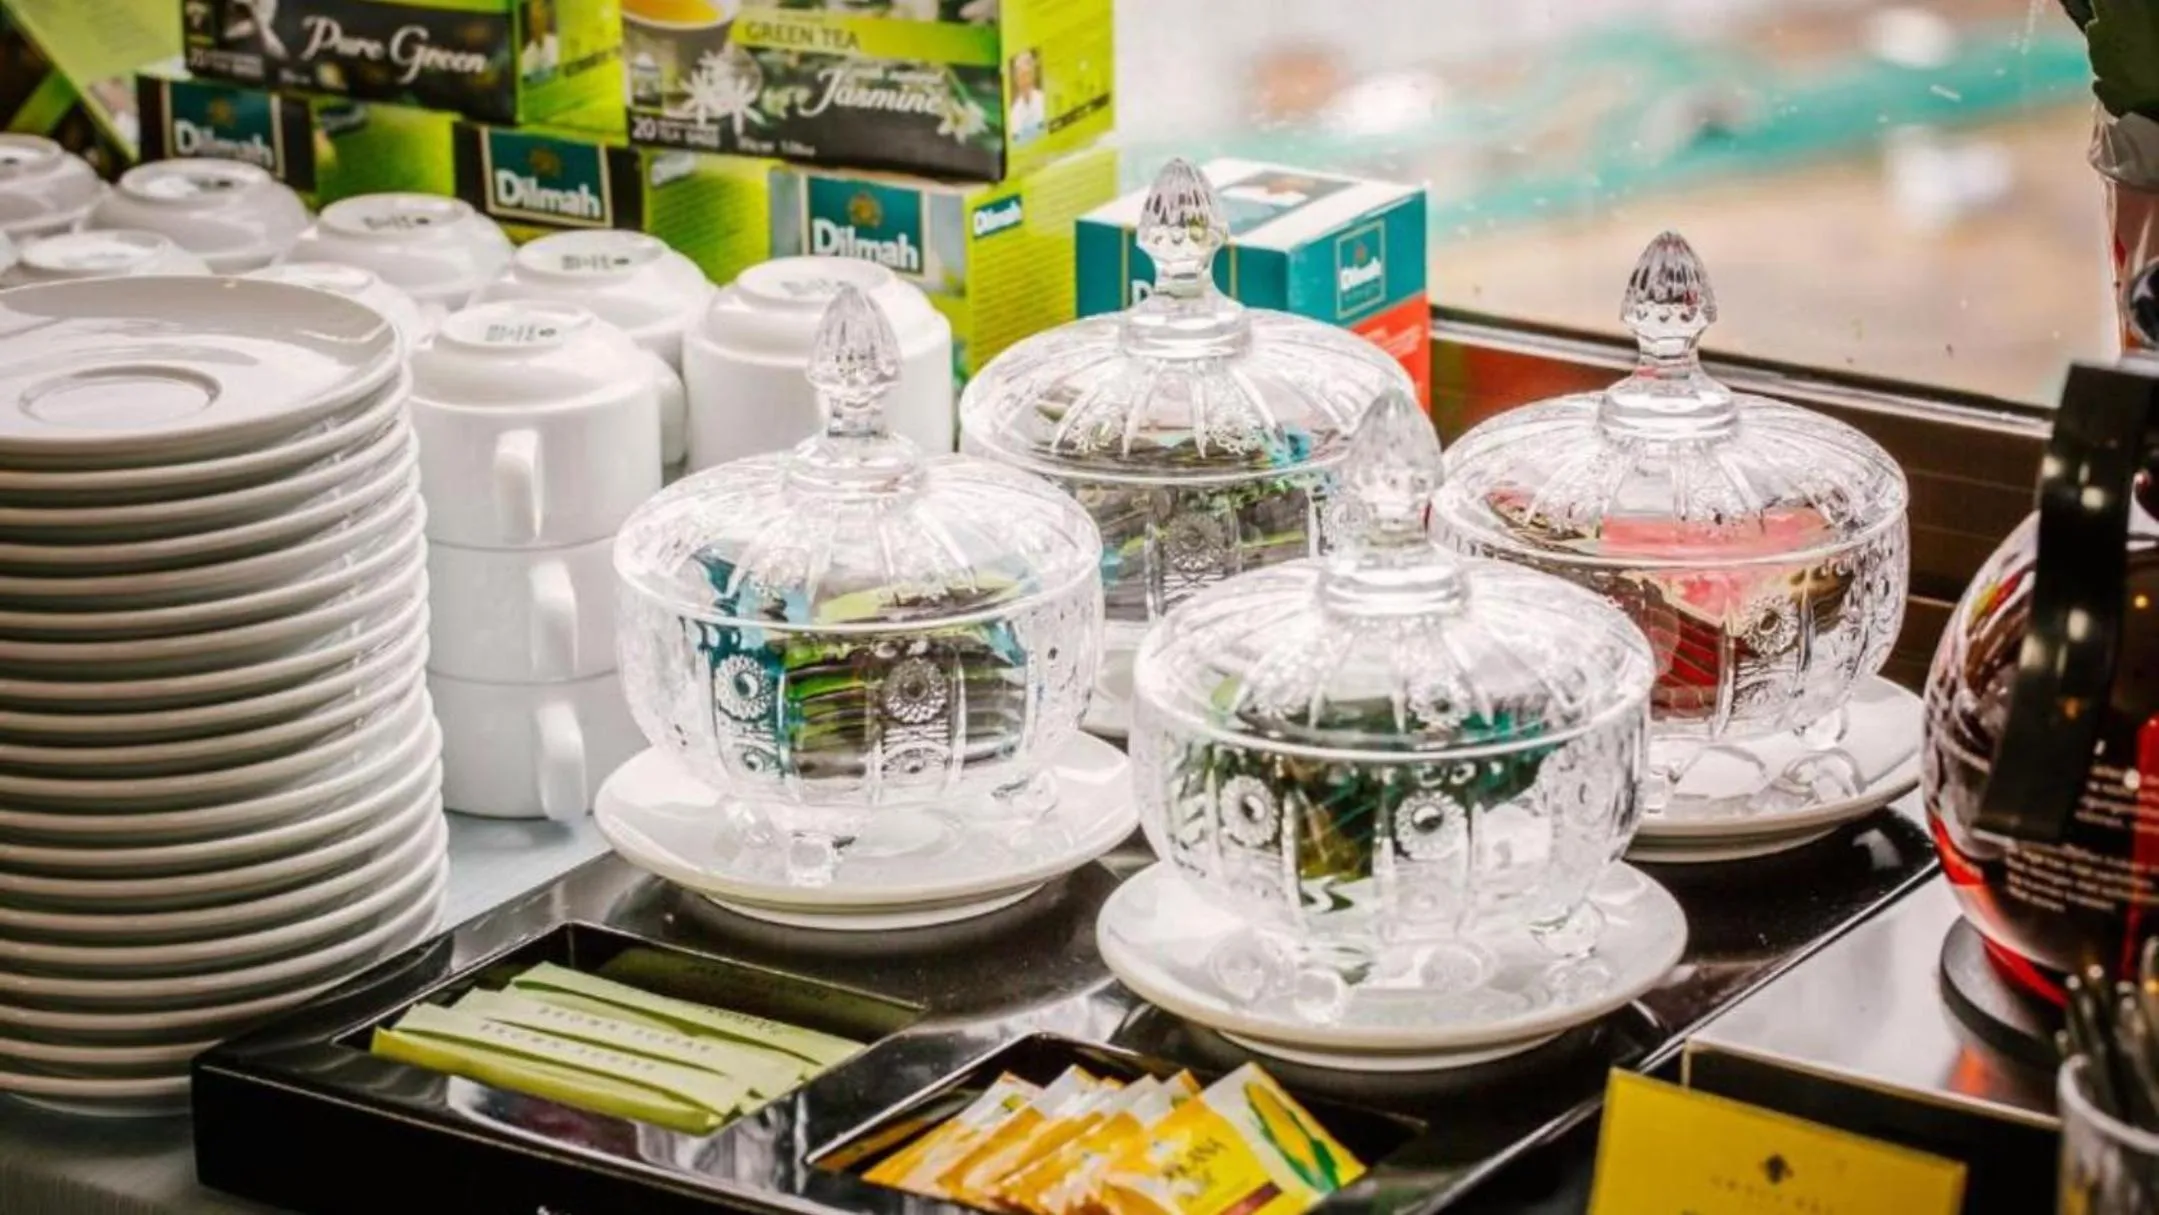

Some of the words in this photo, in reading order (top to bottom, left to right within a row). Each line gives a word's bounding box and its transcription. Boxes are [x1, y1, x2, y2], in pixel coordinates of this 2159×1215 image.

[302, 15, 384, 60] Pure
[390, 25, 488, 84] Green
[745, 20, 814, 45] GREEN
[820, 27, 859, 49] TEA
[798, 66, 941, 118] Jasmine
[174, 118, 274, 169] Dilmah
[632, 117, 657, 140] 20
[495, 168, 601, 219] Dilmah
[813, 217, 919, 271] Dilmah
